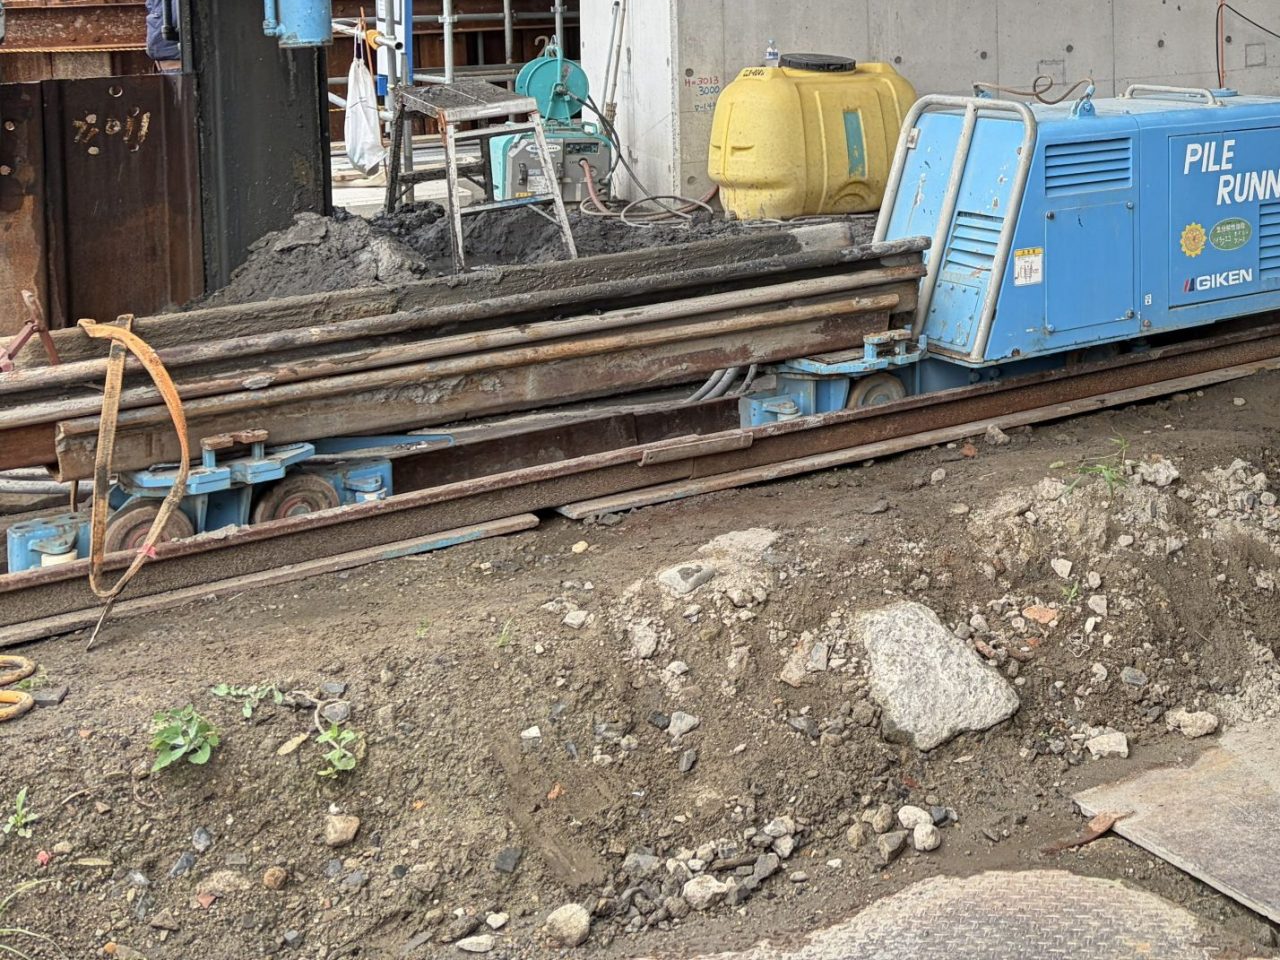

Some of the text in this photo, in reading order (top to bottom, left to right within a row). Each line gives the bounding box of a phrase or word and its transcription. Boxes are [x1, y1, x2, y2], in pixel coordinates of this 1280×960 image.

[698, 85, 720, 96] 3000
[1184, 139, 1236, 175] PILE
[1196, 268, 1253, 291] GIKEN
